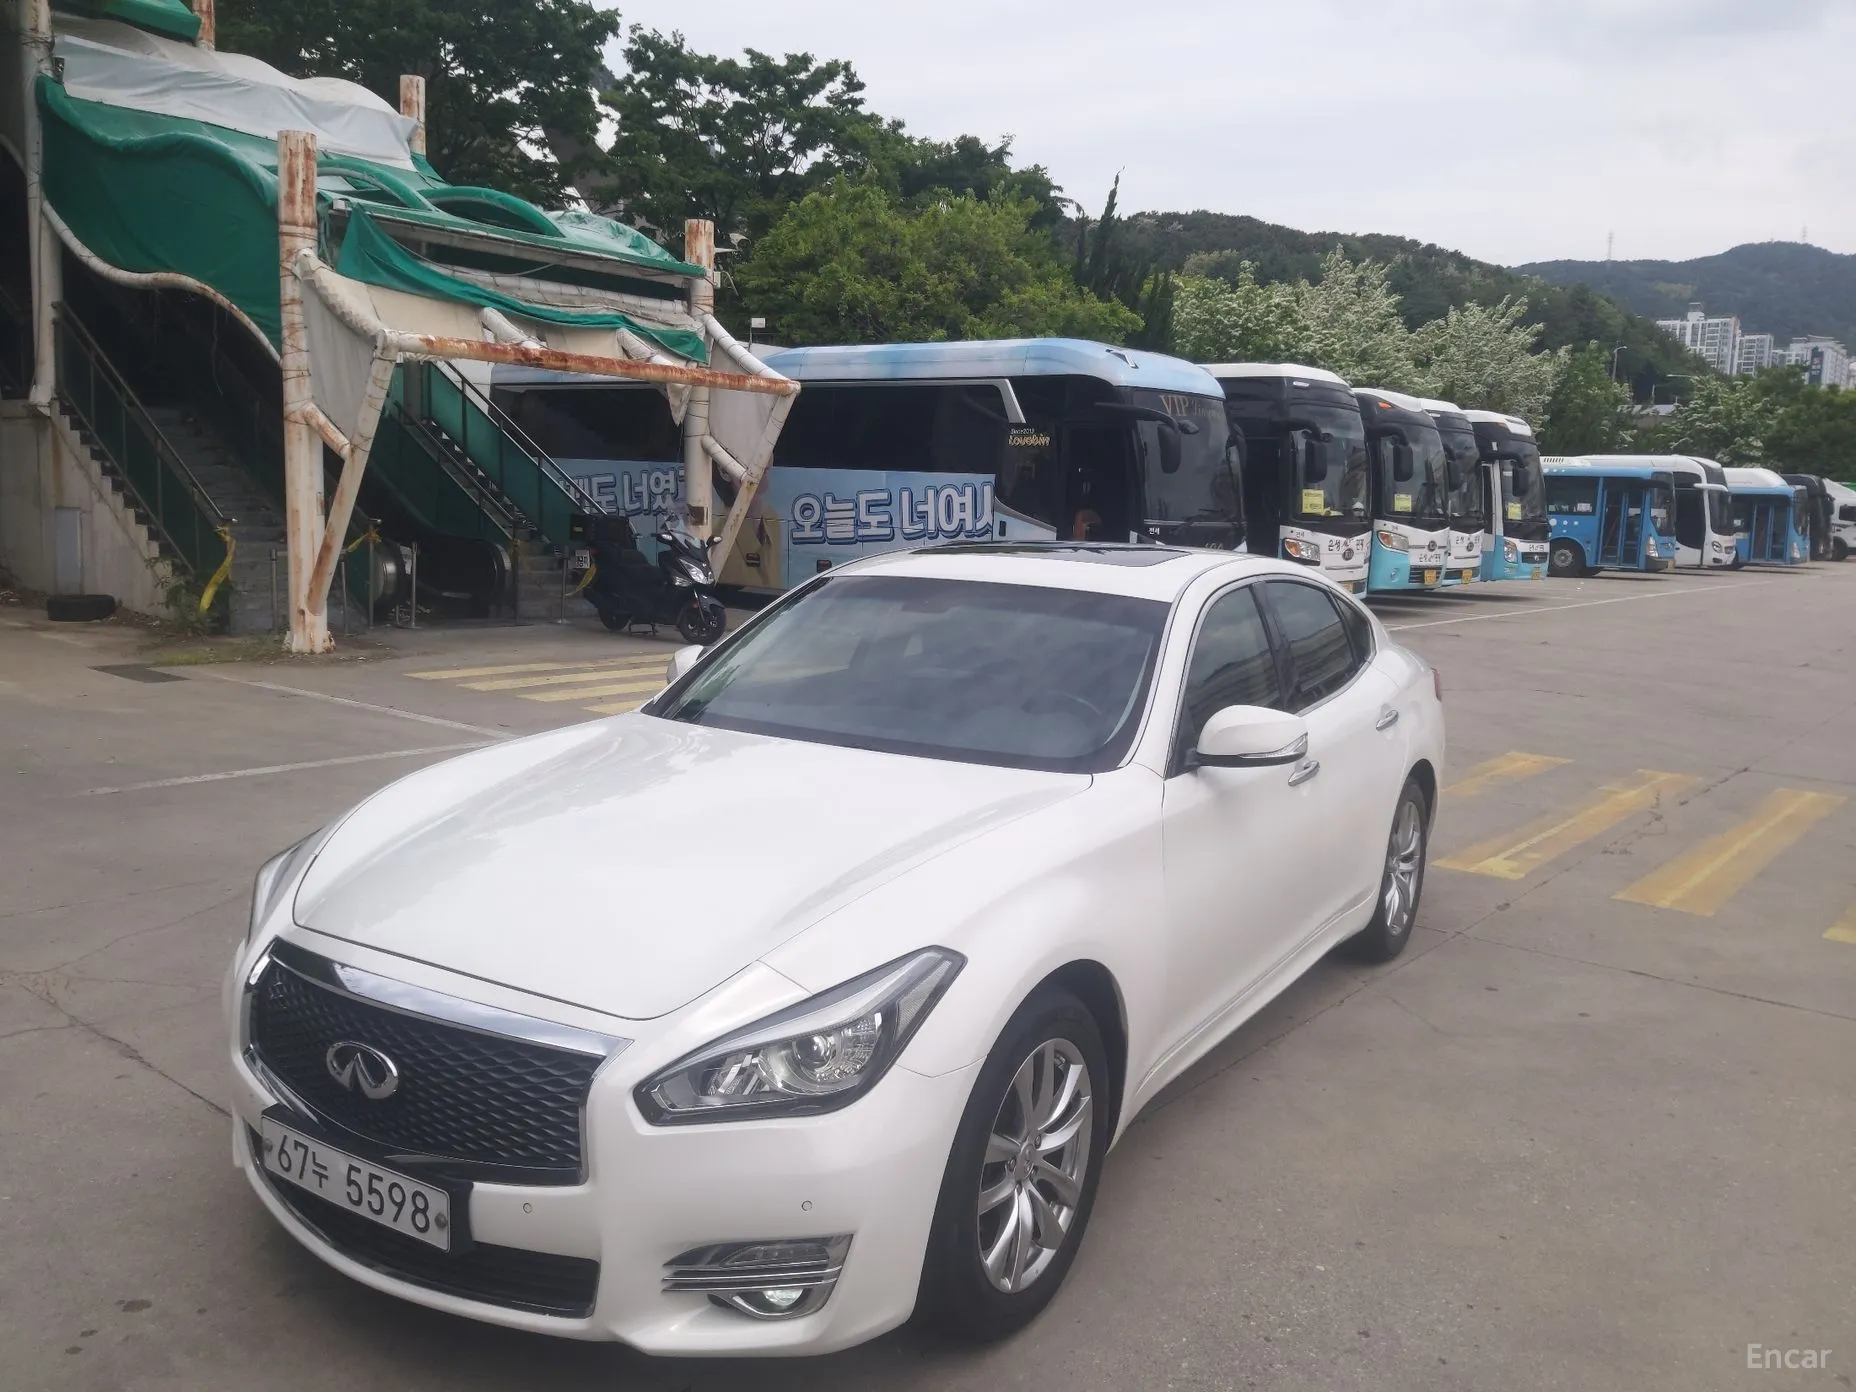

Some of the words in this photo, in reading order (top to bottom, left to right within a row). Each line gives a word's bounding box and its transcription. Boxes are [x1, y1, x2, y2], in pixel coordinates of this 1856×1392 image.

[1159, 394, 1189, 417] VIP
[791, 488, 895, 545] 오늘도
[277, 1134, 329, 1189] 67누
[345, 1163, 431, 1234] 5598
